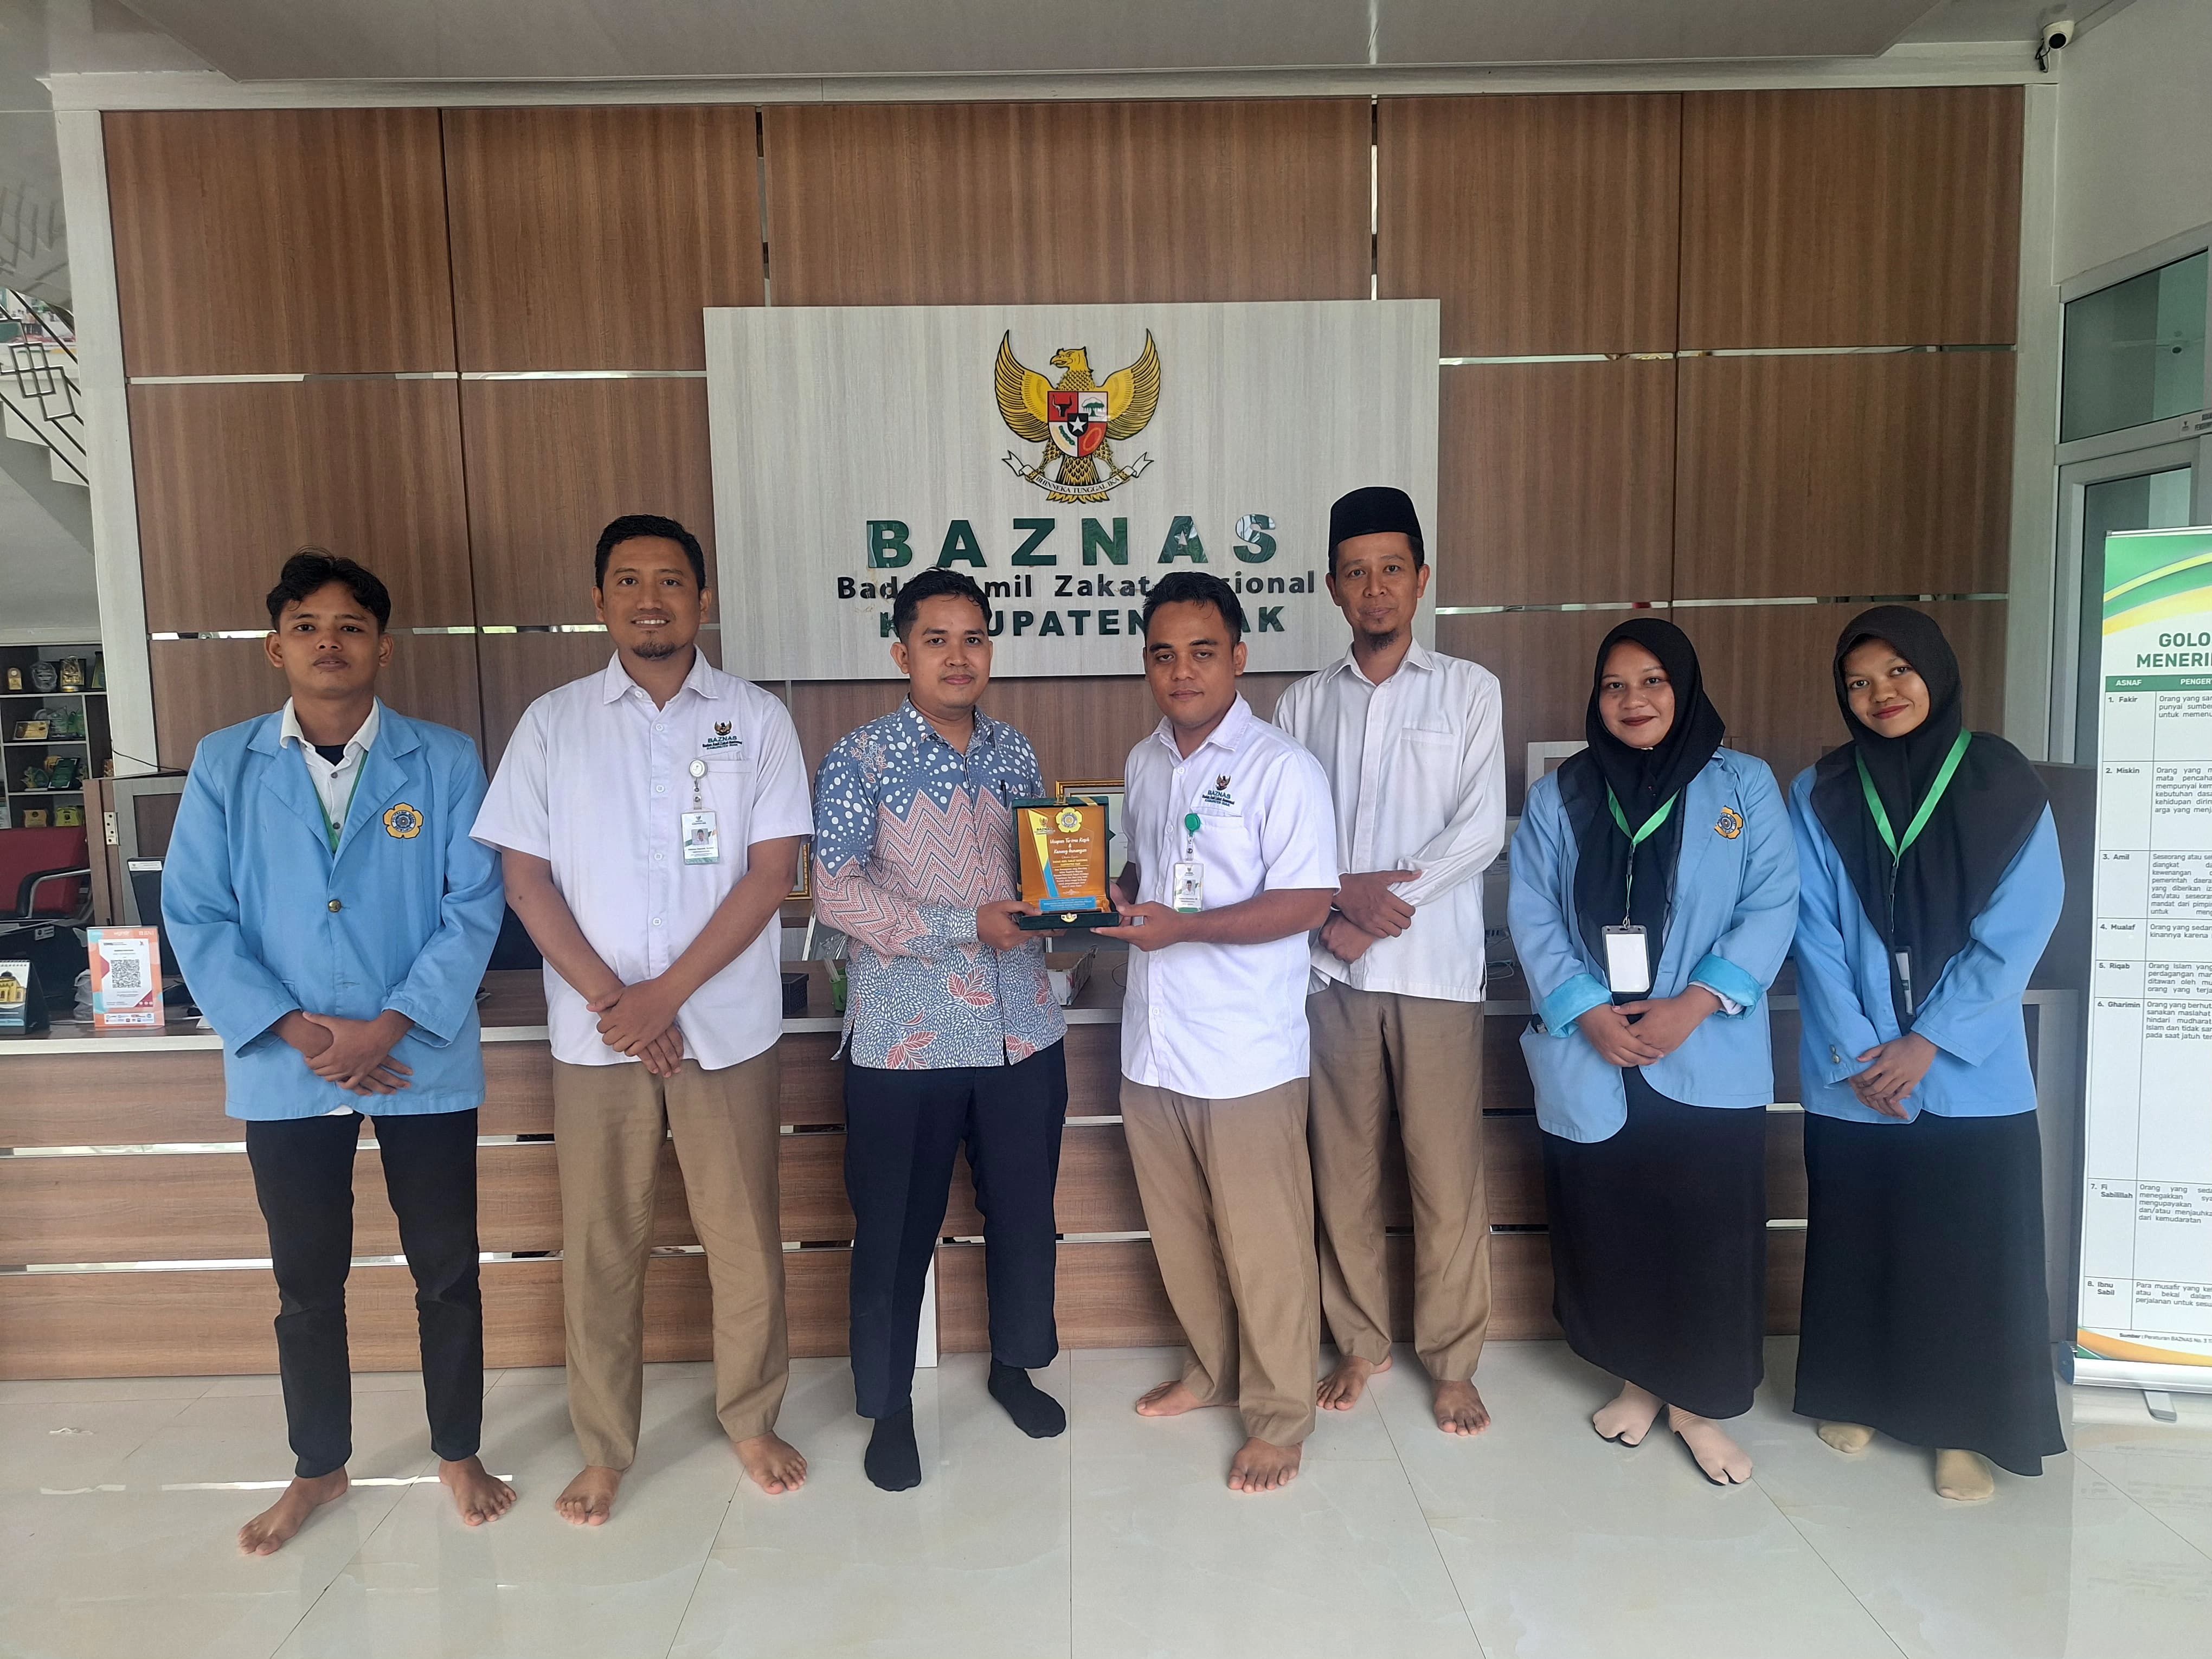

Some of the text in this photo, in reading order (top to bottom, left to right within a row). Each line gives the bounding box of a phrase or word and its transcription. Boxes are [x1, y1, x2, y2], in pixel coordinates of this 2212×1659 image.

[1036, 476, 1120, 494] BHINNEKA TUNGGAL IKA
[866, 513, 1277, 568] BAZNAS
[837, 576, 898, 599] Bad
[1054, 573, 1149, 597] Zakat
[1221, 570, 1314, 594] ional
[880, 608, 1145, 638] KUPATEN
[2159, 632, 2212, 647] GOLO
[2137, 652, 2212, 668] MENERI
[1208, 790, 1231, 799] BAZNAS
